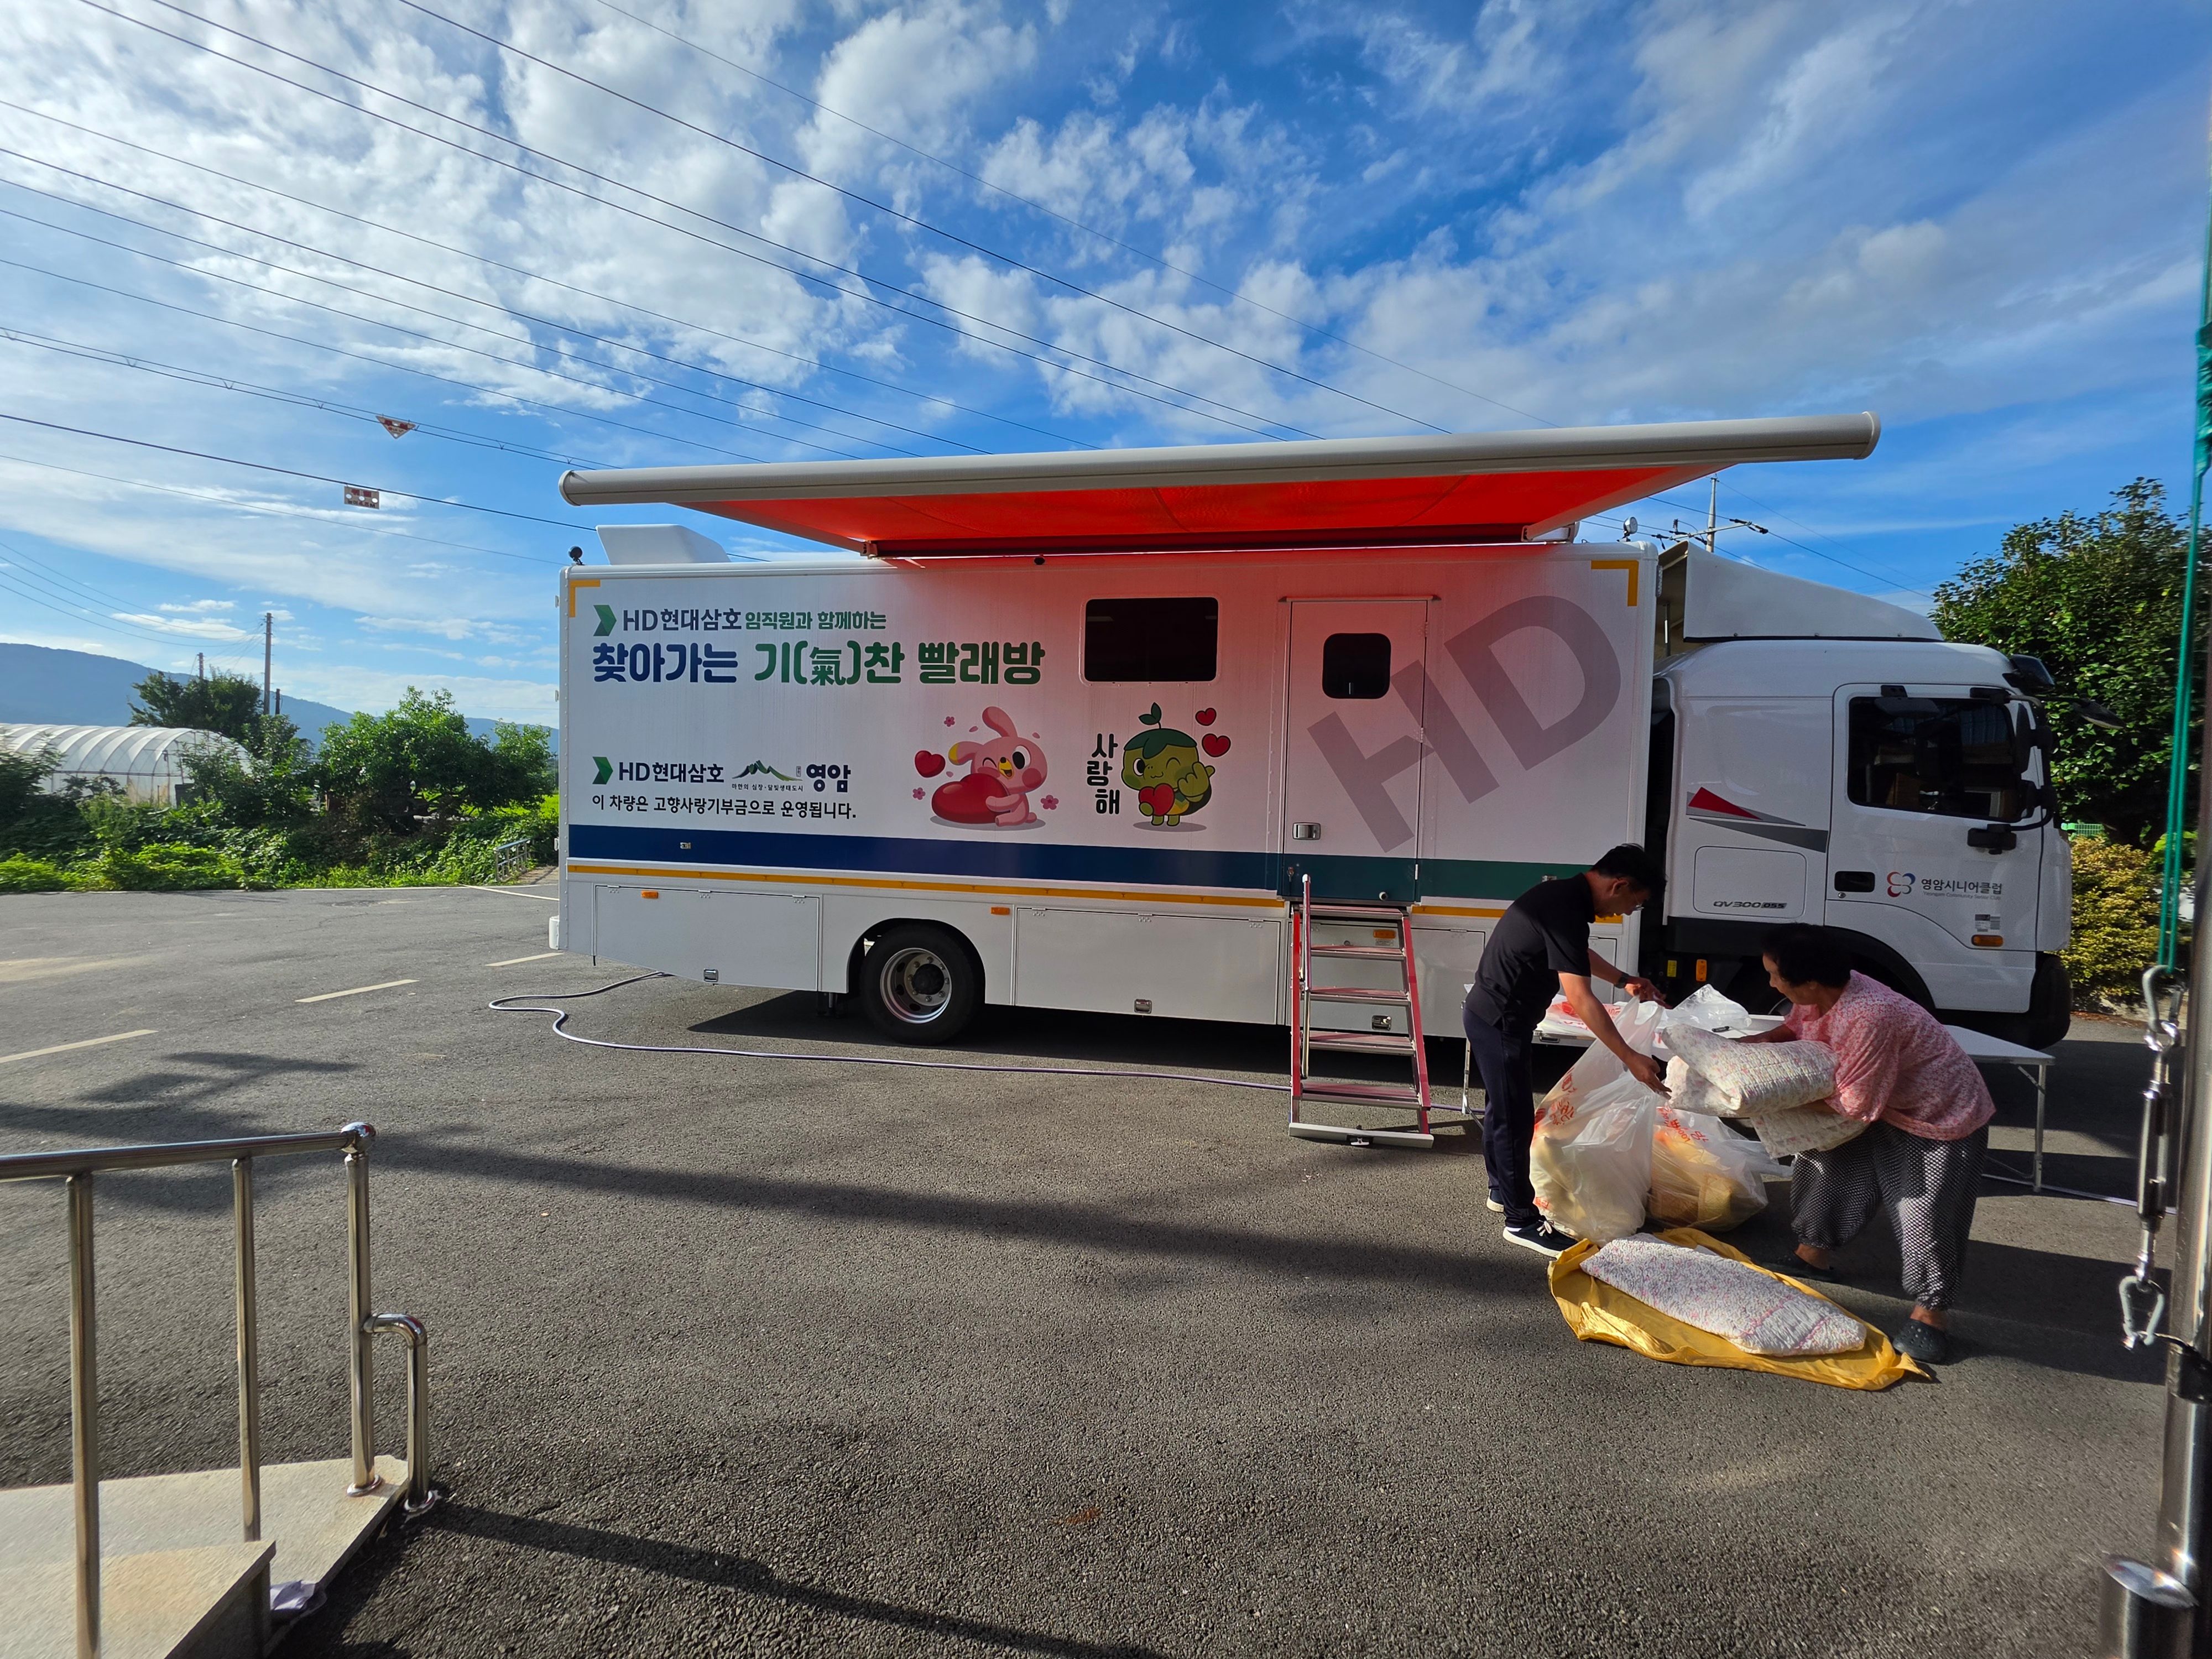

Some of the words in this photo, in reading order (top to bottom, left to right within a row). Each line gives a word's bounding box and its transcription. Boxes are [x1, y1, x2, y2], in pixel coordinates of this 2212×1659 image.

[745, 612, 813, 630] 임직원과
[817, 611, 886, 630] 함께하는
[593, 643, 738, 683] 찾아가는
[754, 640, 906, 686] 기(氣)찬
[918, 641, 1046, 685] 빨래방
[1307, 596, 1621, 853] HD
[806, 764, 851, 793] 영암
[1087, 733, 1120, 815] 사랑해
[592, 795, 604, 811] 이
[609, 795, 649, 812] 차량은
[654, 796, 775, 816] 고향사랑기부금으로
[781, 800, 857, 819] 운영됩니다.
[1921, 879, 2002, 895] 영암시니어클럽
